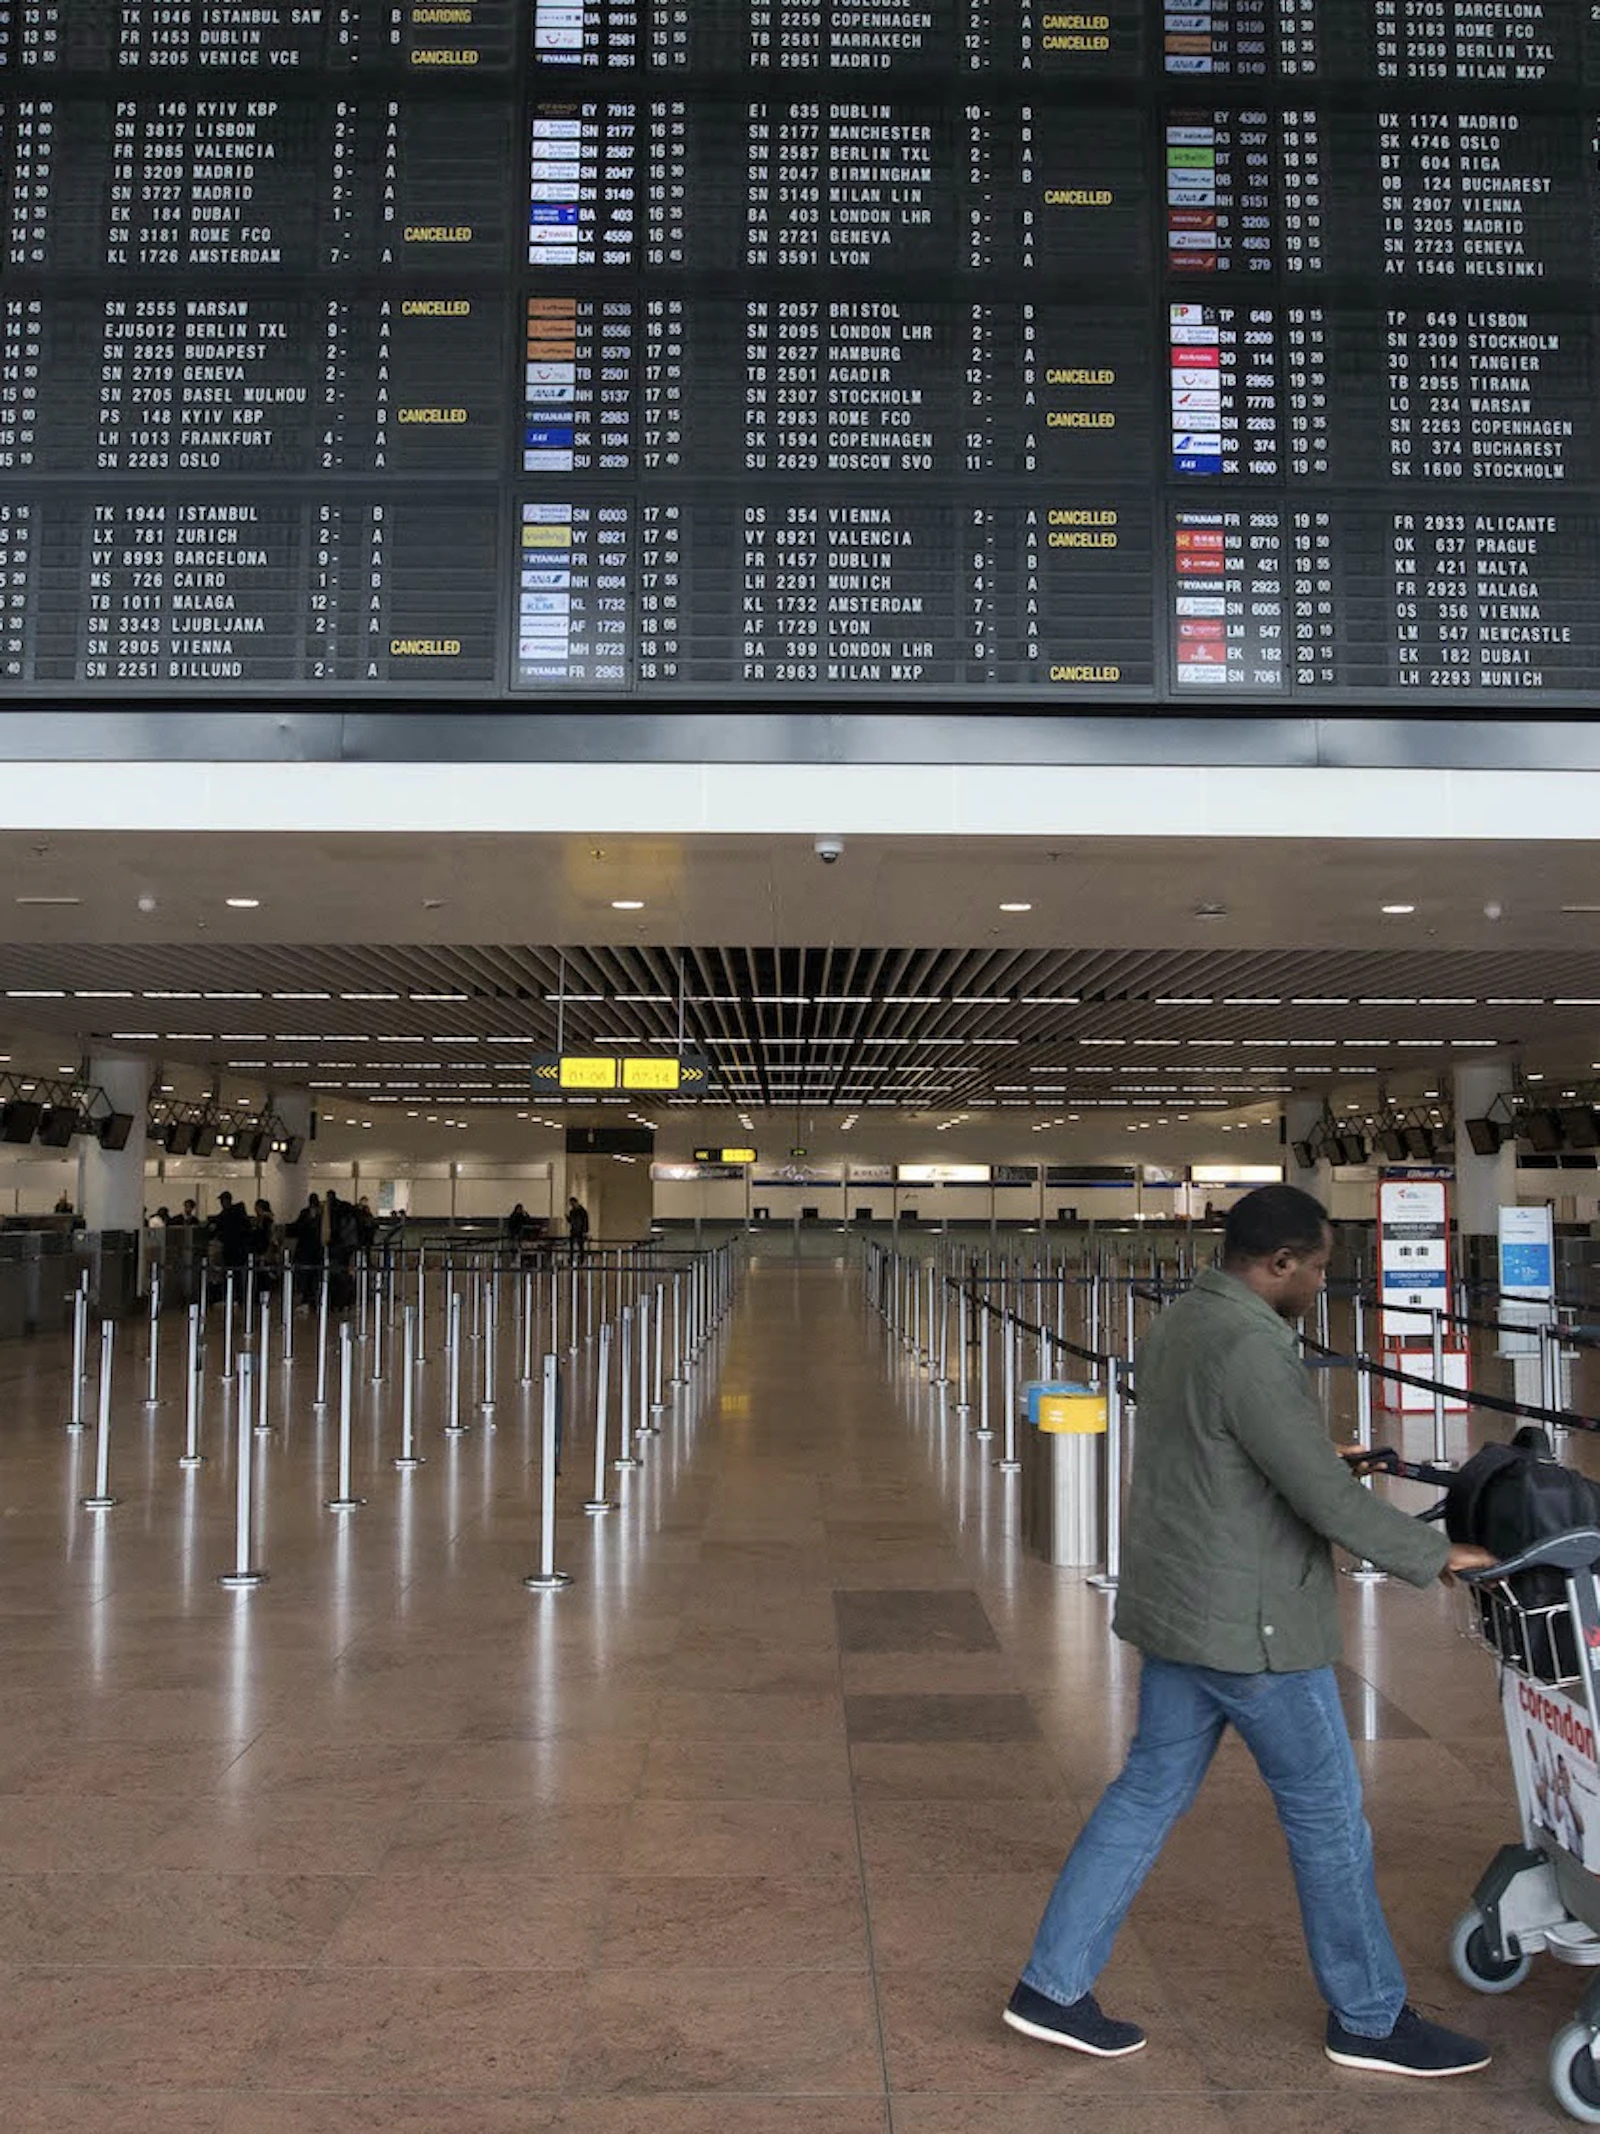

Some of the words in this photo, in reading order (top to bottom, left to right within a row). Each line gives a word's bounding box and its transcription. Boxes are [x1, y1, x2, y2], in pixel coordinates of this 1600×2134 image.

[153, 10, 191, 24] 1946
[203, 9, 280, 24] ISTANBUL
[291, 9, 322, 24] SAW
[412, 8, 472, 23] BOARDING
[1454, 2, 1544, 18] BARCELONA
[831, 12, 931, 28] COPENHAGEN
[1042, 14, 1110, 30] CANCELLED
[152, 30, 190, 45] 1453
[200, 29, 260, 45] DUBLIN
[1455, 23, 1494, 38] ROME
[1505, 24, 1534, 39] FCO
[830, 33, 922, 49] MARRAKECH
[1042, 35, 1110, 50] CANCELLED
[199, 50, 259, 66] VENICE
[269, 50, 299, 66] VCE
[411, 50, 479, 65] CANCELLED
[1456, 43, 1516, 58] BERLIN
[1526, 44, 1554, 60] TXL
[830, 53, 891, 68] MADRID
[1456, 63, 1506, 79] MILAN
[1516, 65, 1546, 79] MXP
[196, 102, 237, 116] KYIV
[247, 101, 278, 117] KBP
[789, 103, 819, 119] 635
[830, 104, 891, 119] DUBLIN
[145, 122, 185, 138] 3817
[195, 122, 256, 138] LISBON
[1458, 114, 1519, 130] MADRID
[779, 124, 819, 140] 2177
[829, 125, 931, 141] MANCHESTER
[1410, 134, 1451, 149] 4746
[1460, 135, 1500, 151] OSLO
[194, 143, 275, 159] VALENCIA
[830, 146, 891, 161] BERLIN
[901, 147, 931, 162] TXL
[1460, 156, 1501, 171] RIGA
[193, 164, 254, 180] MADRID
[779, 166, 819, 181] 2047
[829, 166, 931, 182] BIRMINGHAM
[141, 185, 182, 200] 3727
[192, 185, 253, 200] MADRID
[1462, 177, 1551, 193] BUCHAREST
[829, 187, 880, 202] MILAN
[891, 189, 922, 203] LIN
[1044, 190, 1113, 205] CANCELLED
[191, 206, 240, 221] DUBAI
[1462, 198, 1523, 213] VIENNA
[830, 208, 891, 223] LONDON
[901, 209, 931, 224] LHR
[189, 227, 230, 242] ROME
[241, 227, 271, 242] FCO
[403, 226, 472, 242] CANCELLED
[1463, 218, 1523, 235] MADRID
[830, 229, 891, 244] GENEVA
[1463, 239, 1524, 255] GENEVA
[140, 249, 178, 264] 1726
[189, 248, 281, 263] AMSTERDAM
[830, 250, 870, 265] LYON
[1416, 260, 1455, 275] 1546
[1465, 260, 1544, 276] HELSINKI
[187, 301, 248, 316] WARSAW
[401, 300, 470, 316] CANCELLED
[779, 302, 819, 318] 2057
[829, 302, 900, 318] BRISTOL
[1467, 312, 1528, 328] LISBON
[104, 323, 176, 338] EJU5012
[185, 323, 247, 338] BERLIN
[258, 323, 287, 338] TXL
[830, 324, 891, 339] LONDON
[902, 325, 933, 340] LHR
[1467, 333, 1559, 350] STOCKHOLM
[185, 344, 266, 360] BUDAPEST
[828, 346, 901, 362] HAMBURG
[1469, 355, 1540, 371] TANGIER
[132, 366, 173, 381] 2719
[183, 365, 244, 381] GENEVA
[777, 367, 816, 382] 2501
[828, 367, 890, 382] AGADIR
[1046, 369, 1115, 385] CANCELLED
[1419, 375, 1459, 391] 2955
[1470, 376, 1530, 392] TIRANA
[183, 387, 233, 403] BASEL
[244, 387, 307, 403] MULHOU
[828, 389, 922, 405] STOCKHOLM
[1470, 398, 1531, 413] WARSAW
[181, 409, 223, 424] KYIV
[233, 409, 264, 424] KBP
[398, 408, 467, 423] CANCELLED
[828, 410, 869, 426] ROME
[881, 410, 911, 426] FCO
[1046, 412, 1115, 428] CANCELLED
[1471, 419, 1572, 436] COPENHAGEN
[130, 431, 170, 446] 1013
[181, 430, 272, 446] FRANKFURT
[828, 432, 932, 448] COPENHAGEN
[1472, 441, 1562, 457] BUCHAREST
[179, 452, 220, 468] OSLO
[828, 454, 891, 470] MOSCOW
[901, 454, 933, 470] SVO
[1473, 462, 1564, 479] STOCKHOLM
[126, 506, 165, 521] 1944
[178, 506, 258, 521] ISTANBUL
[828, 508, 891, 523] VIENNA
[1048, 510, 1117, 525] CANCELLED
[1475, 516, 1556, 533] ALICANTE
[176, 528, 237, 544] ZURICH
[828, 530, 912, 546] VALENCIA
[1048, 532, 1117, 548] CANCELLED
[1476, 538, 1537, 554] PRAGUE
[174, 550, 267, 566] BARCELONA
[777, 552, 817, 567] 1457
[828, 552, 891, 568] DUBLIN
[1477, 560, 1529, 576] MALTA
[174, 572, 225, 588] CAIRO
[828, 575, 891, 591] MUNICH
[1477, 582, 1539, 598] MALAGA
[172, 594, 235, 610] MALAGA
[828, 597, 922, 613] AMSTERDAM
[1479, 604, 1540, 620] VIENNA
[119, 617, 160, 633] 3343
[172, 617, 265, 632] LJUBLJANA
[777, 619, 817, 635] 1729
[828, 619, 870, 635] LYON
[1439, 625, 1468, 641] 547
[1479, 626, 1571, 642] NEWCASTLE
[171, 639, 233, 654] VIENNA
[390, 640, 461, 655] CANCELLED
[828, 642, 891, 657] LONDON
[902, 642, 933, 658] LHR
[1481, 648, 1530, 664] DUBAI
[118, 662, 157, 677] 2251
[169, 661, 242, 677] BILLUND
[828, 664, 880, 680] MILAN
[891, 665, 923, 680] MXP
[1050, 665, 1120, 681] CANCELLED
[1430, 670, 1471, 686] 2293
[1481, 670, 1542, 686] MUNICH
[1518, 1680, 1599, 1763] corendon
